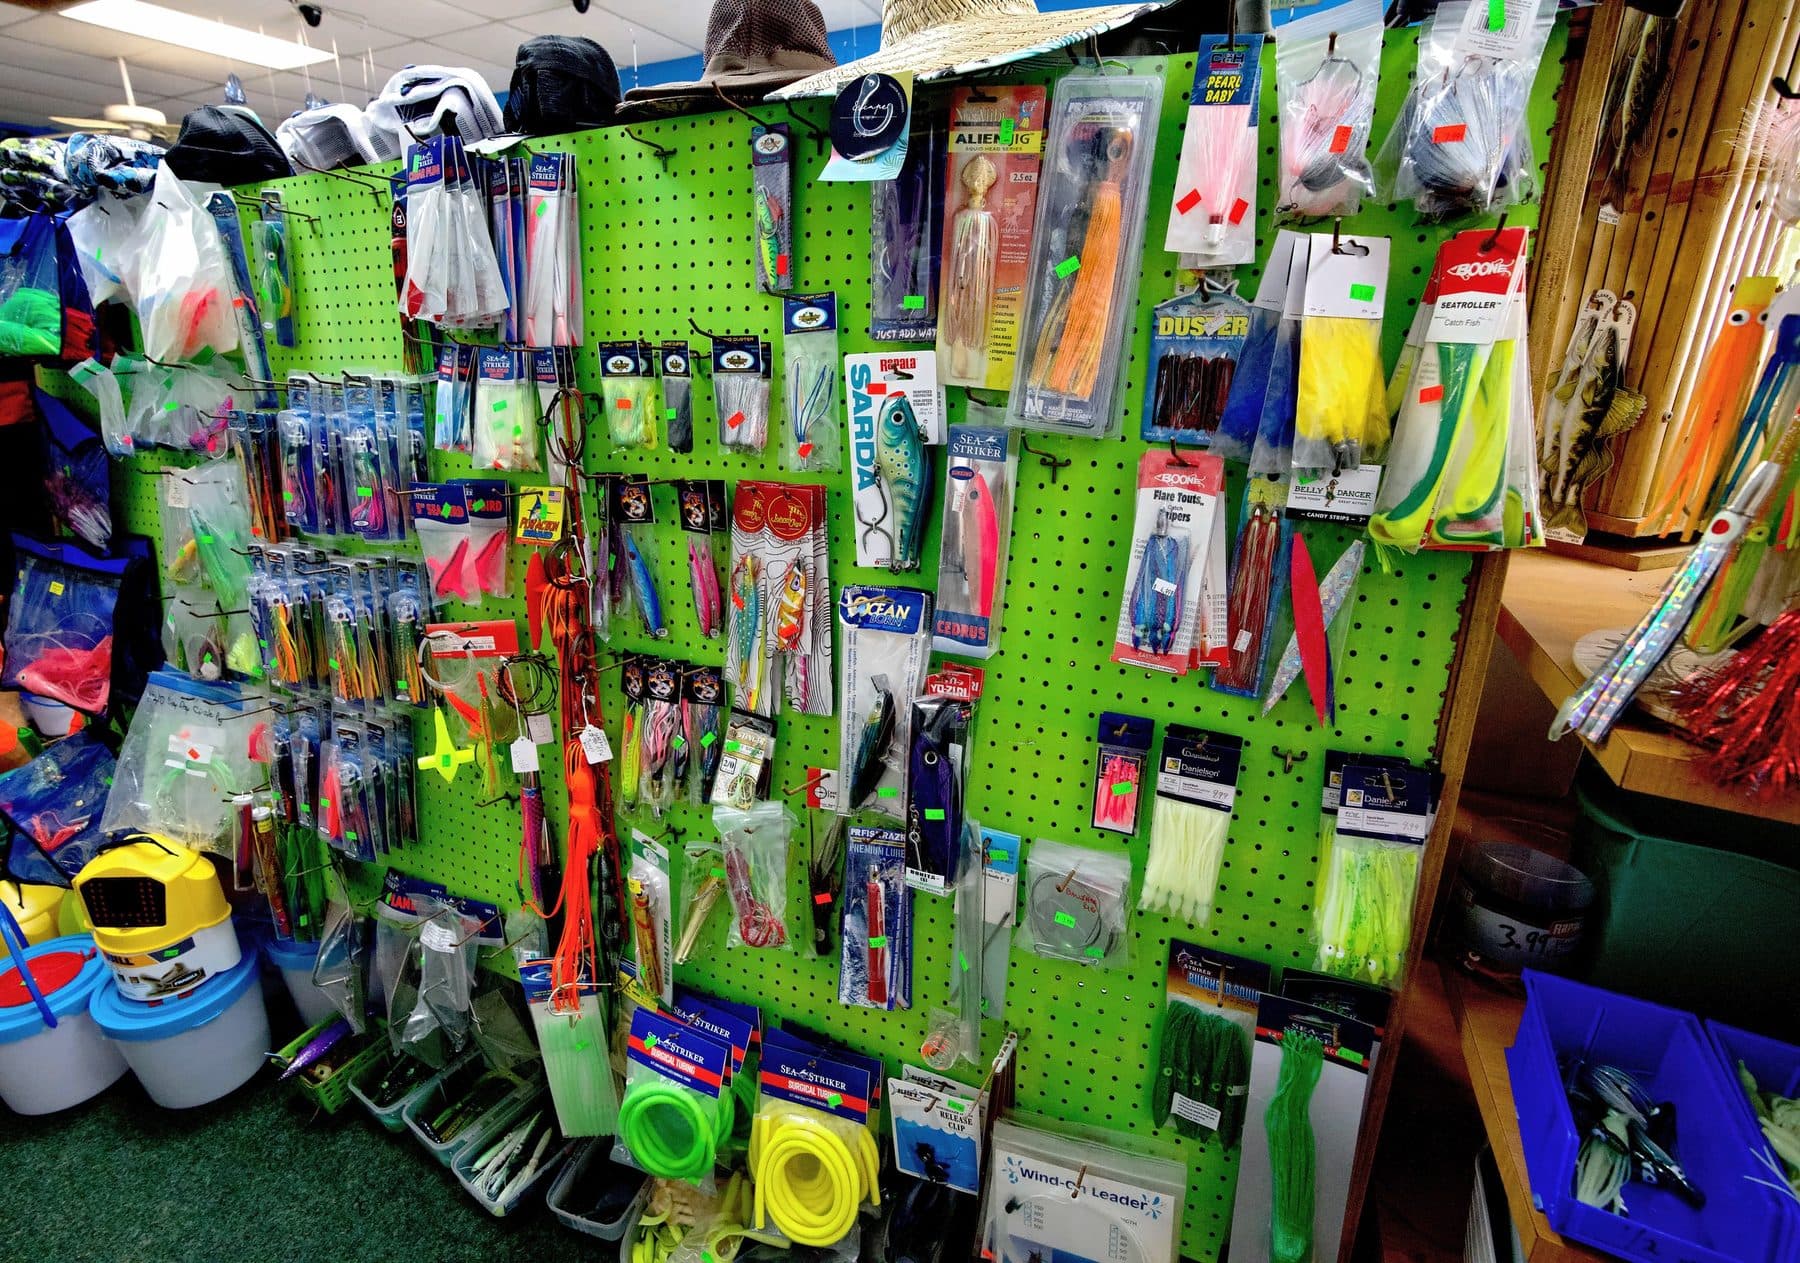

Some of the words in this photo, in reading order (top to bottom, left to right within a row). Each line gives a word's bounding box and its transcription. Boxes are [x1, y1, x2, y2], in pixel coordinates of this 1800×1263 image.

[1207, 75, 1241, 89] PEARL
[1205, 89, 1235, 103] BABY
[532, 171, 557, 180] STRIKER
[536, 164, 551, 173] SEA
[1014, 173, 1024, 181] 2.5
[1456, 261, 1511, 277] BOONE
[1441, 301, 1496, 309] SEATROLLER
[1444, 319, 1463, 327] Catch
[1466, 319, 1480, 327] Fish
[876, 330, 897, 340] JUST
[899, 330, 916, 338] ADD
[482, 362, 511, 370] STRIKER
[850, 363, 877, 491] SARDA
[952, 443, 1001, 458] STRIKER
[1153, 489, 1175, 502] Flare
[1295, 485, 1324, 494] BELLY
[1337, 489, 1371, 499] DANCER
[1171, 511, 1192, 523] ripers
[1329, 514, 1350, 522] STRIPS
[937, 620, 986, 640] CEDRUS
[723, 759, 735, 769] 2/0
[1182, 763, 1219, 777] Danielson
[850, 843, 884, 857] PREMIUM
[886, 848, 905, 859] LURE
[1498, 924, 1550, 953] 3.99
[1183, 964, 1212, 976] STRIKER
[1189, 959, 1202, 967] SEA
[694, 1016, 731, 1039] STRIKER
[650, 1048, 676, 1067] SURGICAL
[670, 1043, 705, 1065] STRIKER
[788, 1080, 816, 1097] SURGICAL
[808, 1071, 848, 1092] STRIKER
[939, 1110, 973, 1127] RELEASE
[948, 1121, 966, 1132] CLIP
[1092, 1187, 1148, 1211] Leader
